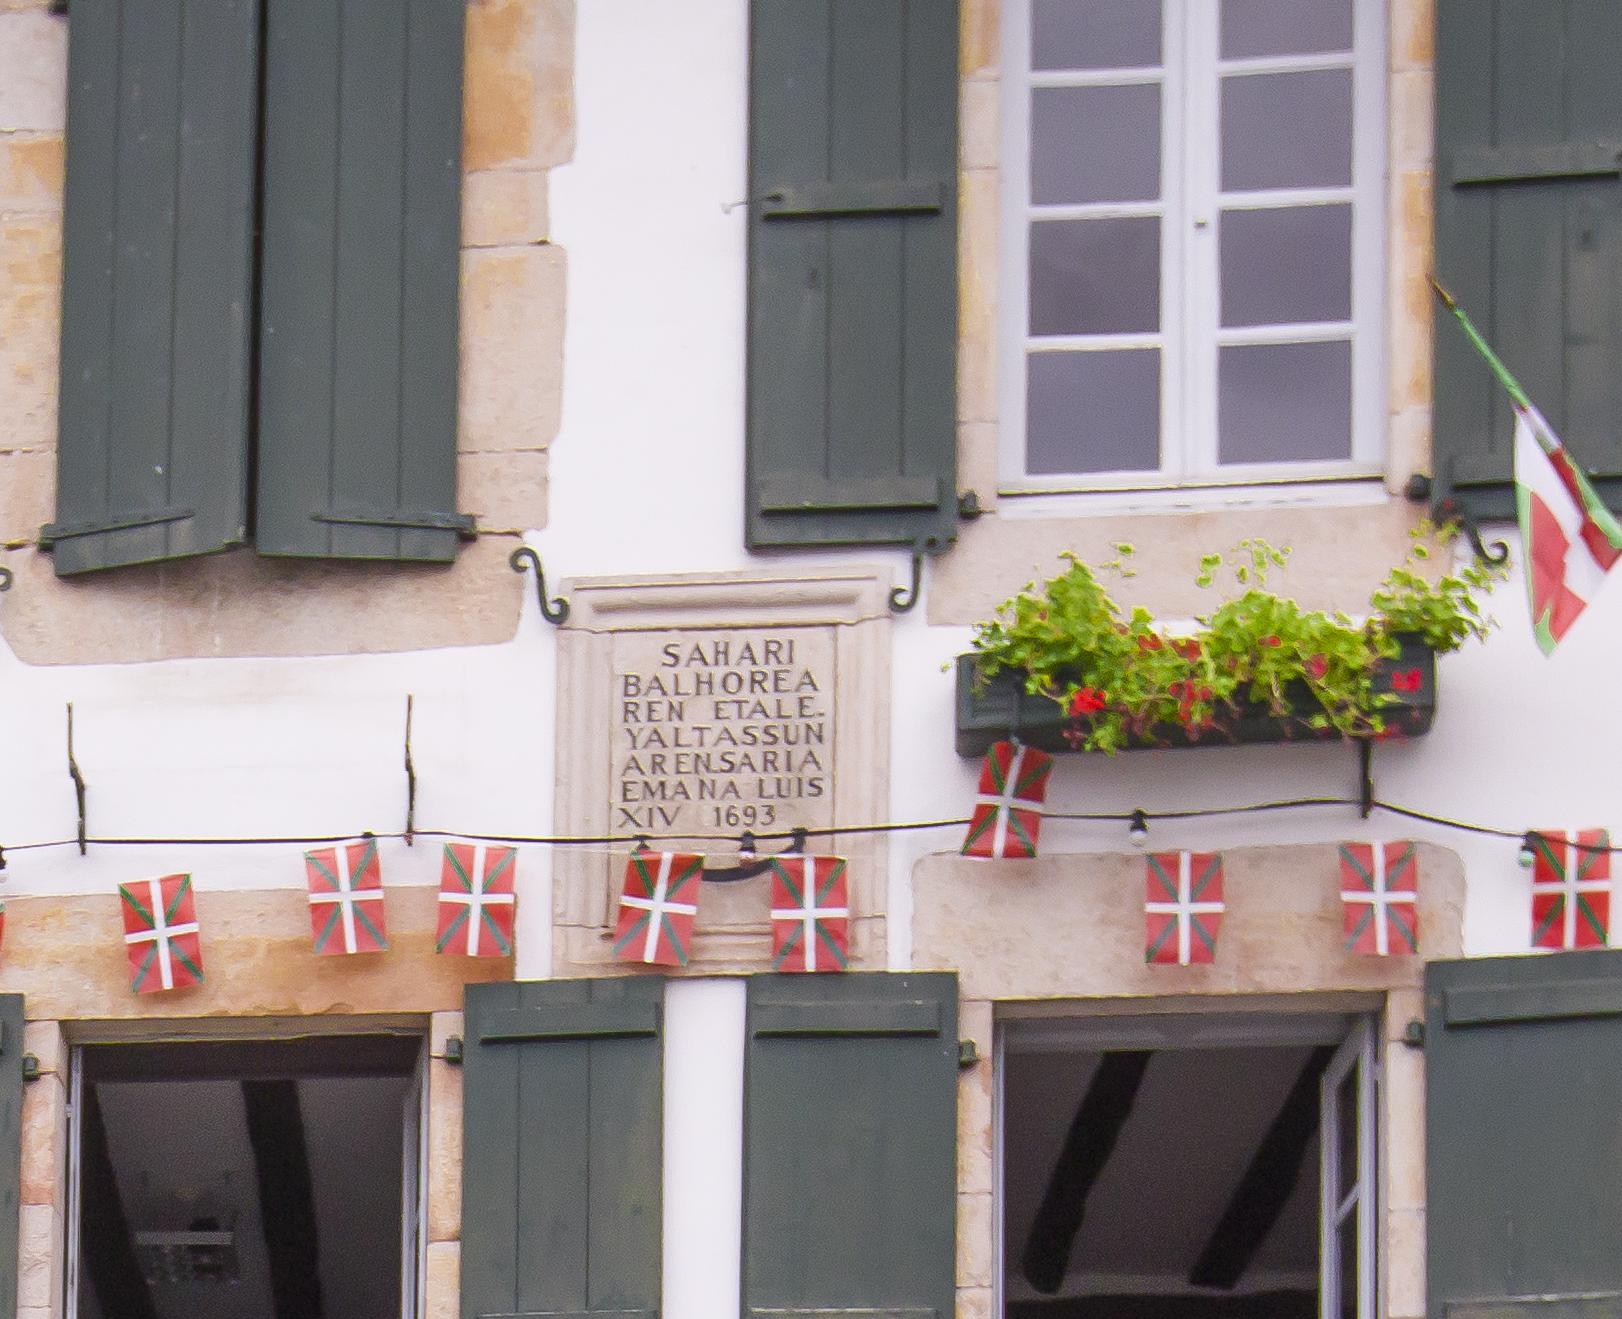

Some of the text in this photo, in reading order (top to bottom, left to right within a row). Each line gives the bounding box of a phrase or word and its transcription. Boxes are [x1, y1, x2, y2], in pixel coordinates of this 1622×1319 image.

[662, 638, 795, 667] SAHARI
[623, 668, 820, 697] BALHOREA
[623, 699, 685, 722] REN
[624, 722, 824, 749] YALTASSUN
[622, 776, 824, 803] EMANA LUIS
[618, 804, 776, 828] XIV 1693
